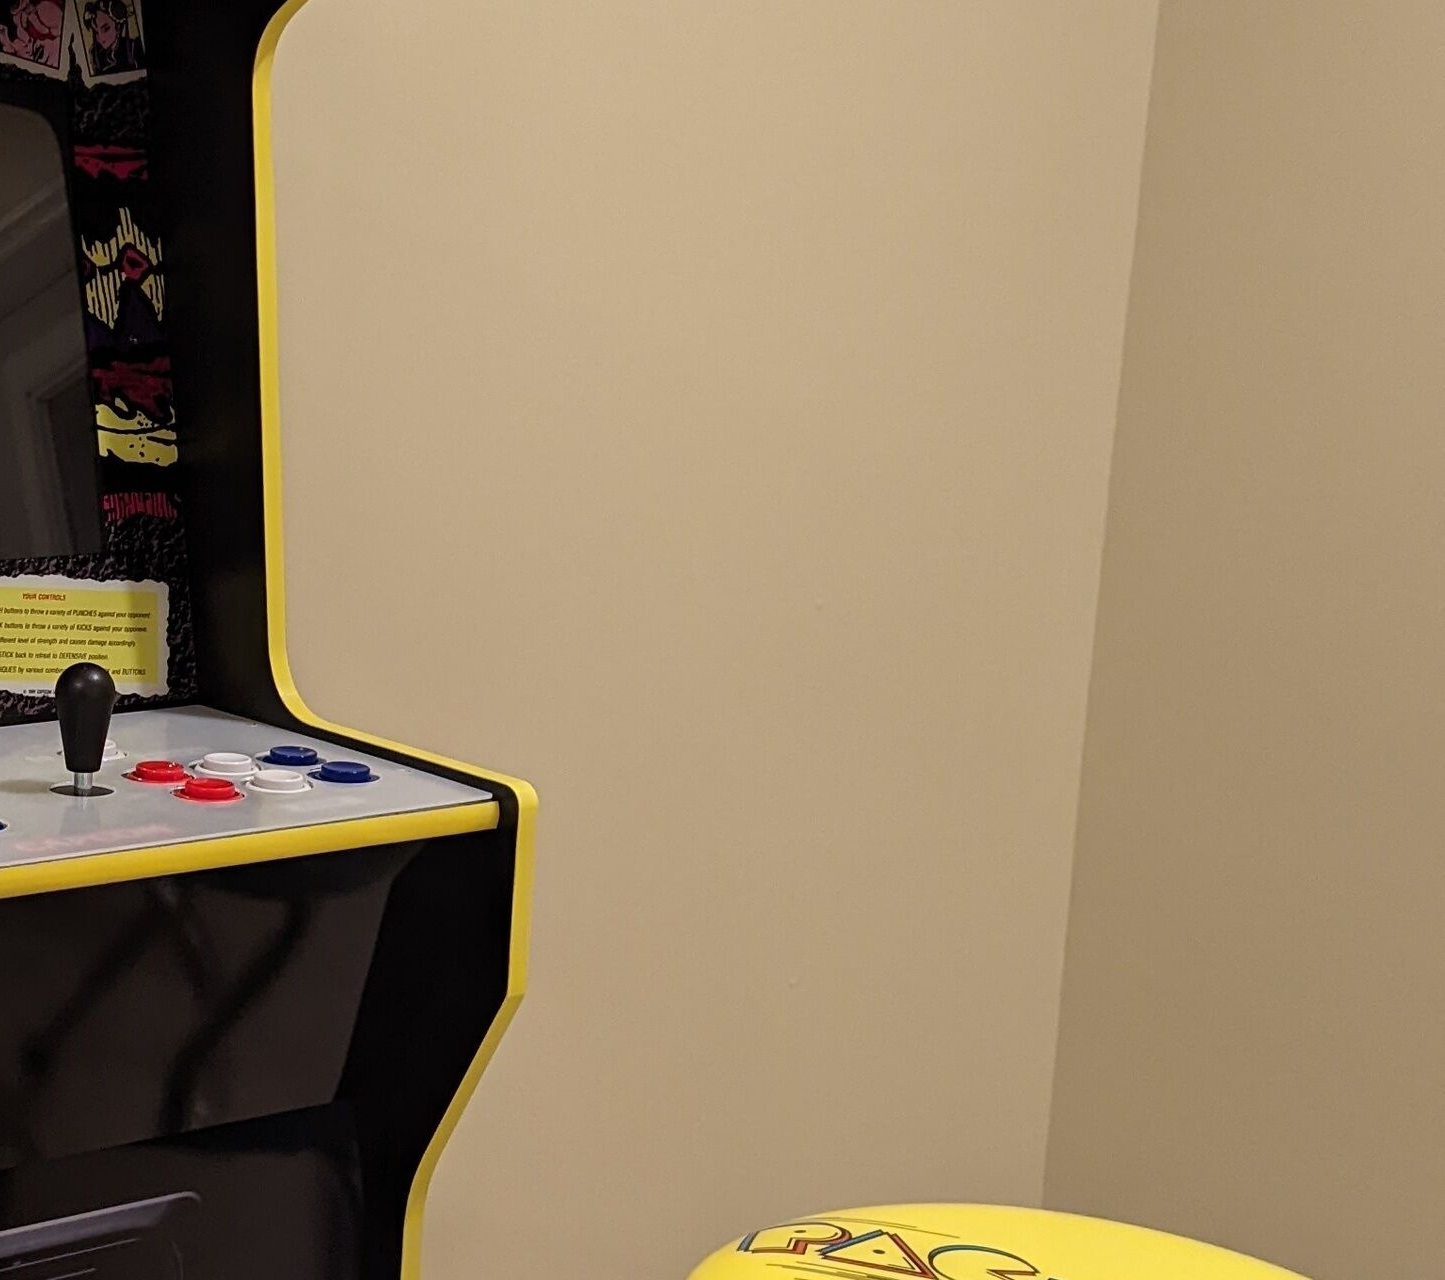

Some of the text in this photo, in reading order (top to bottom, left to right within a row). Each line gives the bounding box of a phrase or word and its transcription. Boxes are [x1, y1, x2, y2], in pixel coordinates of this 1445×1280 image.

[73, 609, 97, 617] PUNCHES
[88, 639, 107, 647] damage
[59, 652, 87, 660] DEFENSIVE
[18, 666, 24, 674] by
